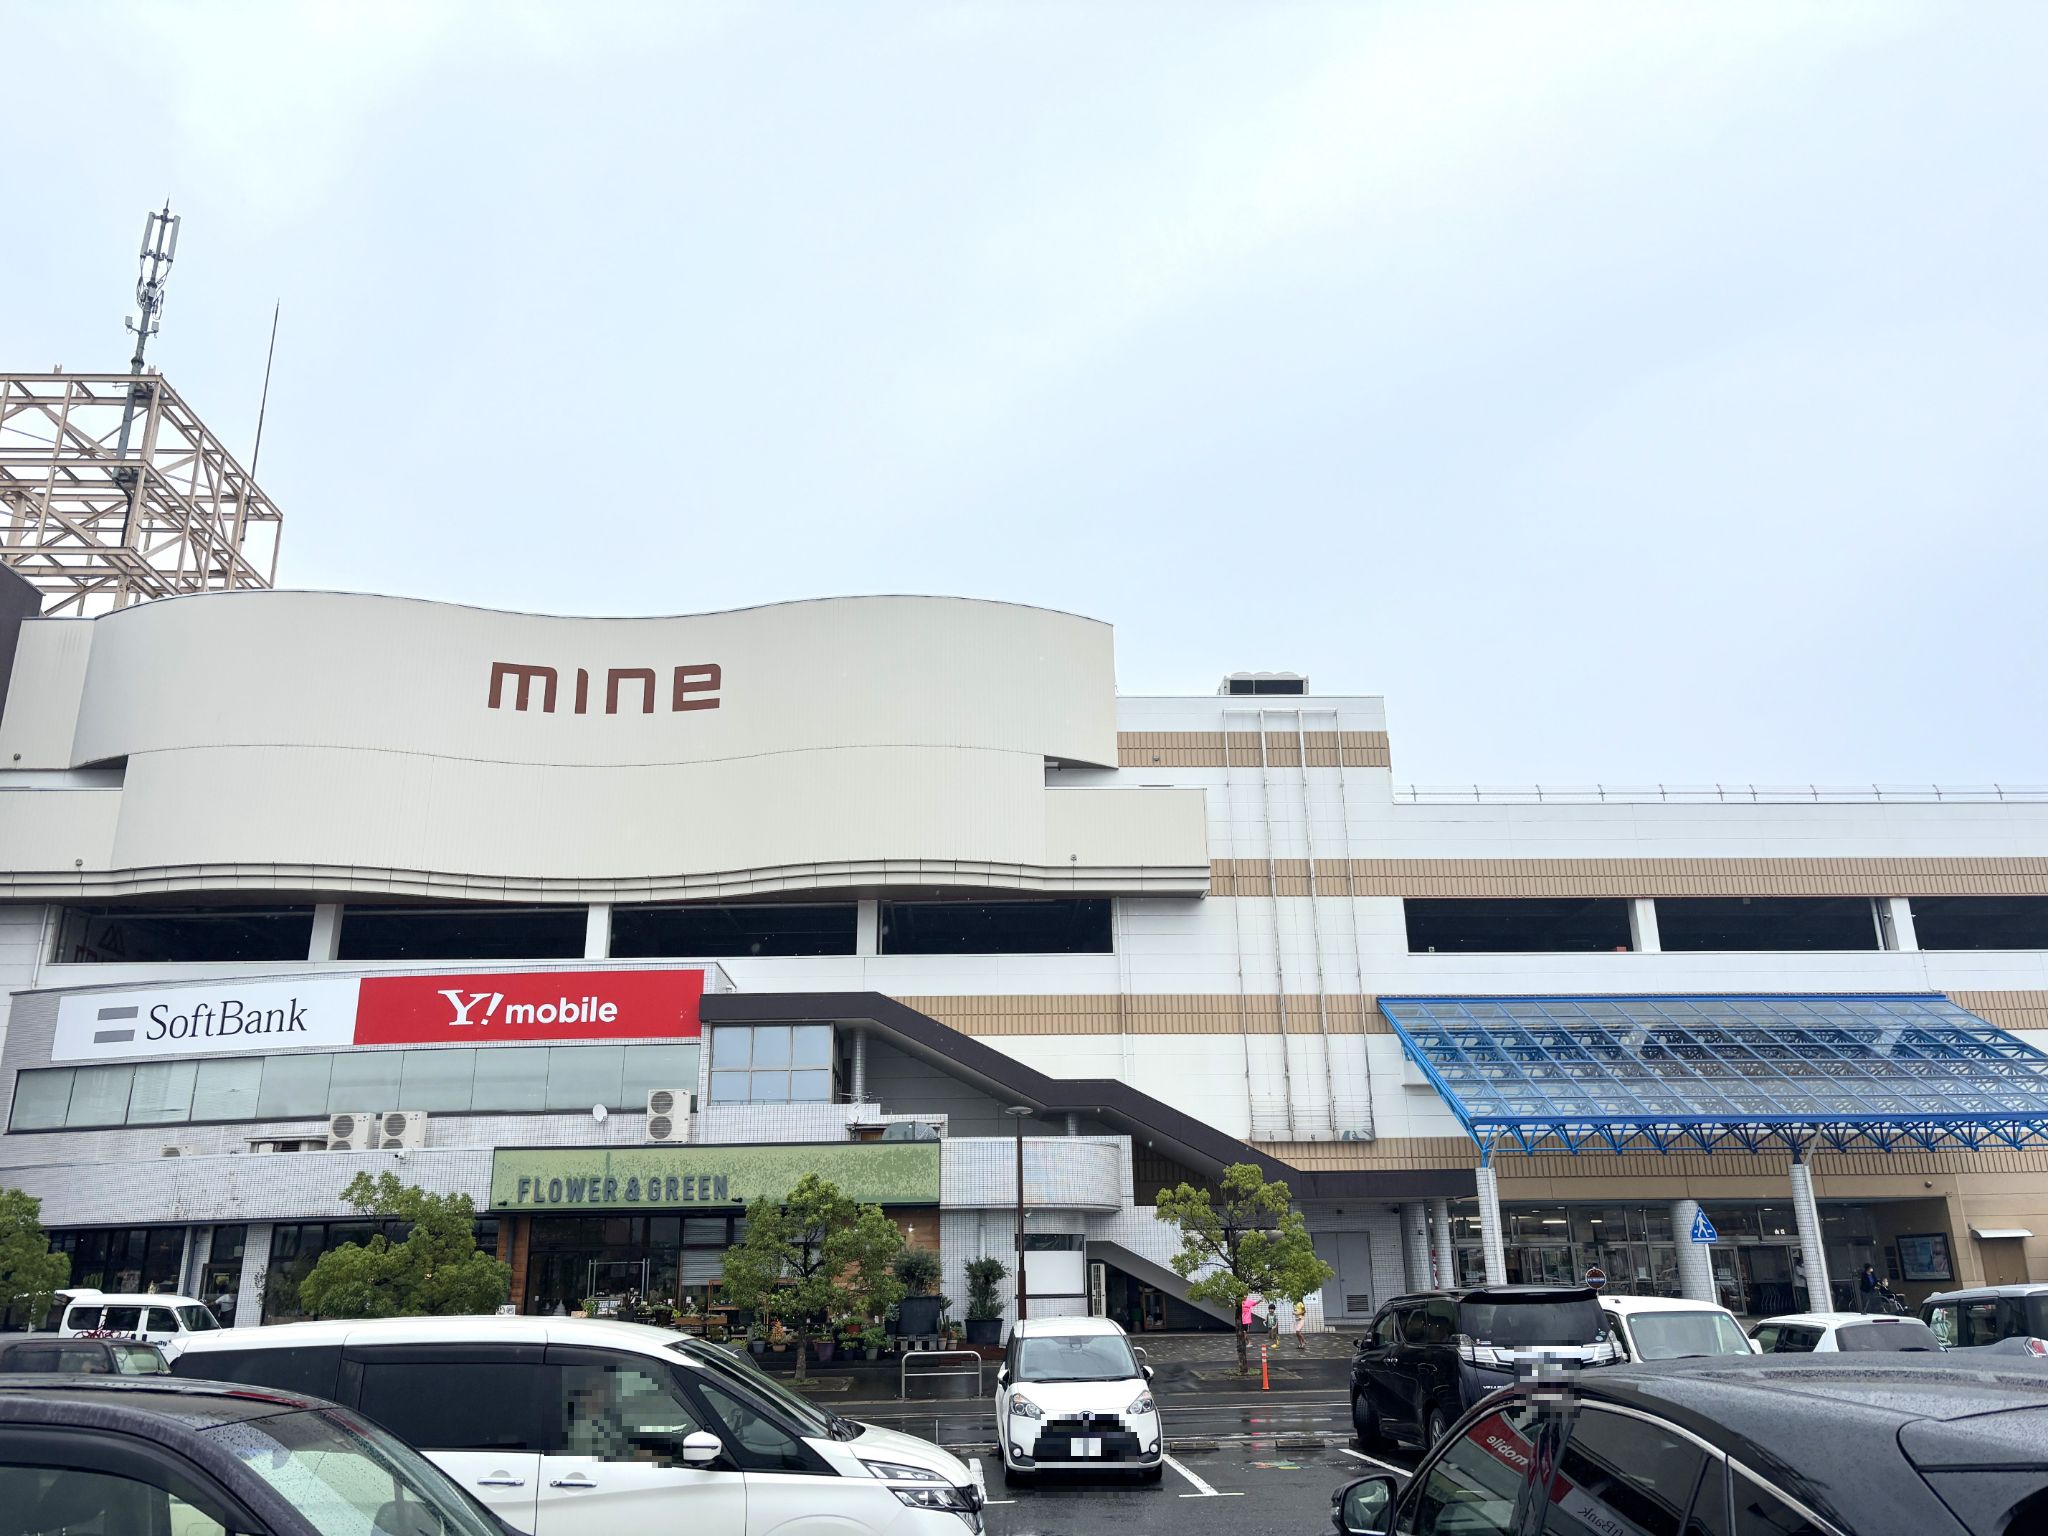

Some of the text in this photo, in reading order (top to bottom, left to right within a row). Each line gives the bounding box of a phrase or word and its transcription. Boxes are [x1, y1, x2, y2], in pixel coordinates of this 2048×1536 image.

[488, 662, 721, 714] mine
[146, 998, 307, 1041] SoftBank
[517, 1175, 728, 1203] FLOWER & GREEN
